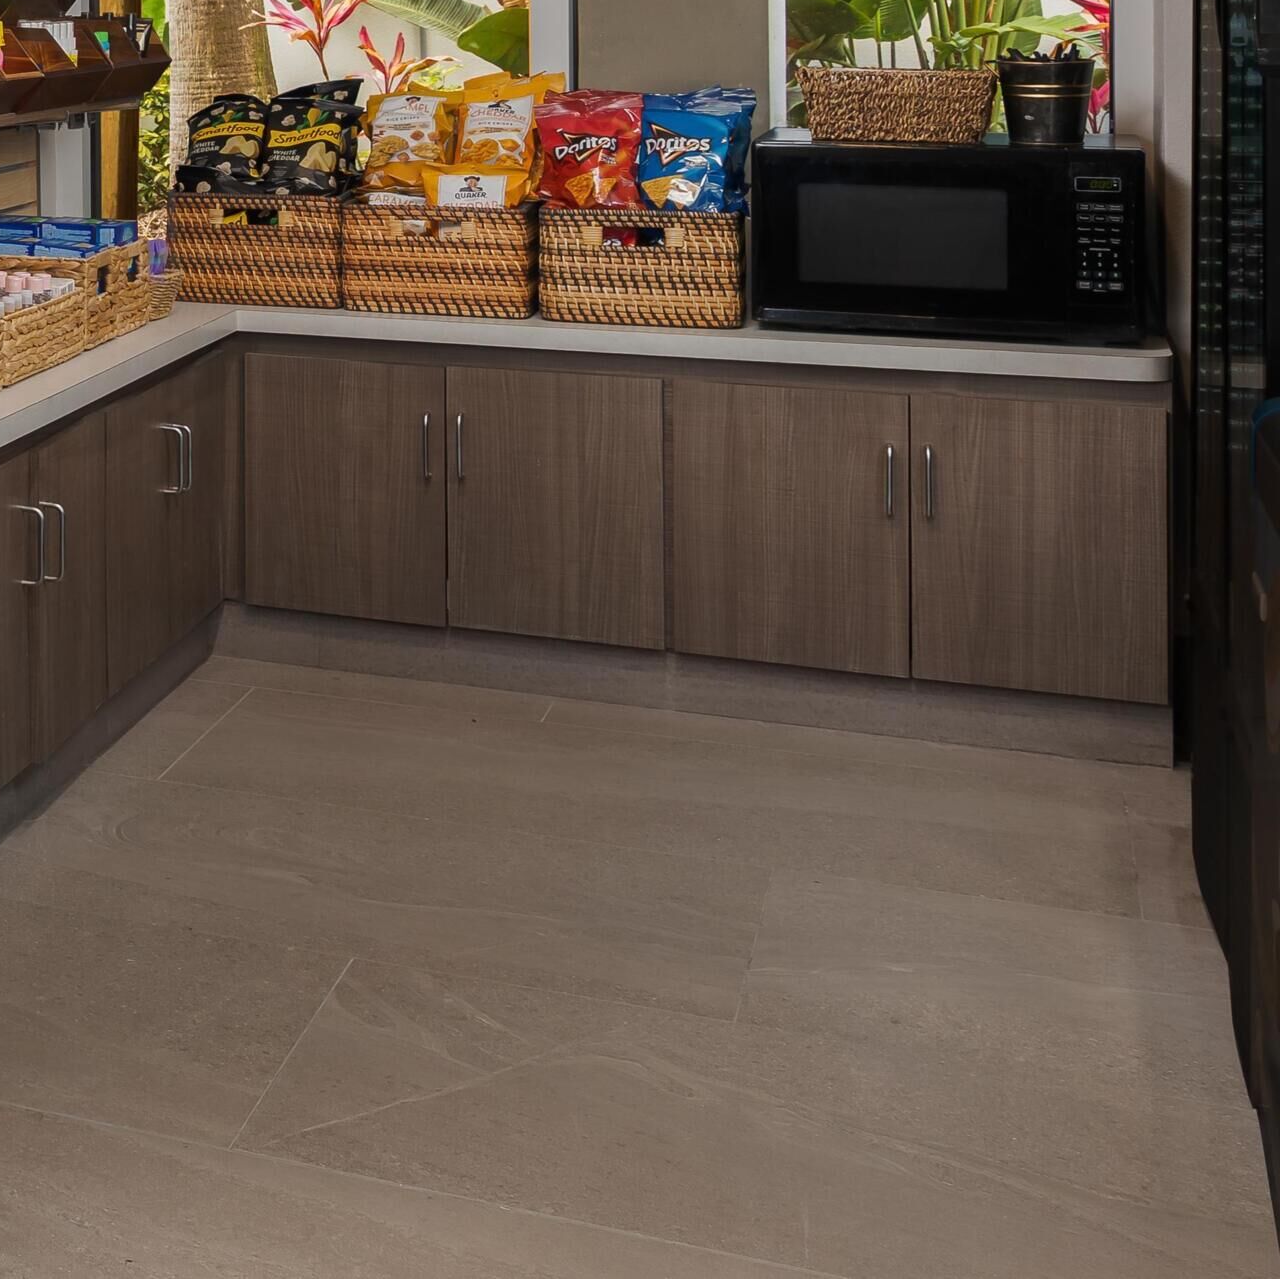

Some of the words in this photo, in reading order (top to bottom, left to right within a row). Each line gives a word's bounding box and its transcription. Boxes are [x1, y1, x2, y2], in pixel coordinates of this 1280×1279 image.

[196, 124, 260, 138] Smartfood
[274, 128, 341, 144] Smartfood
[555, 137, 616, 160] Doritos
[645, 138, 710, 155] Doritos
